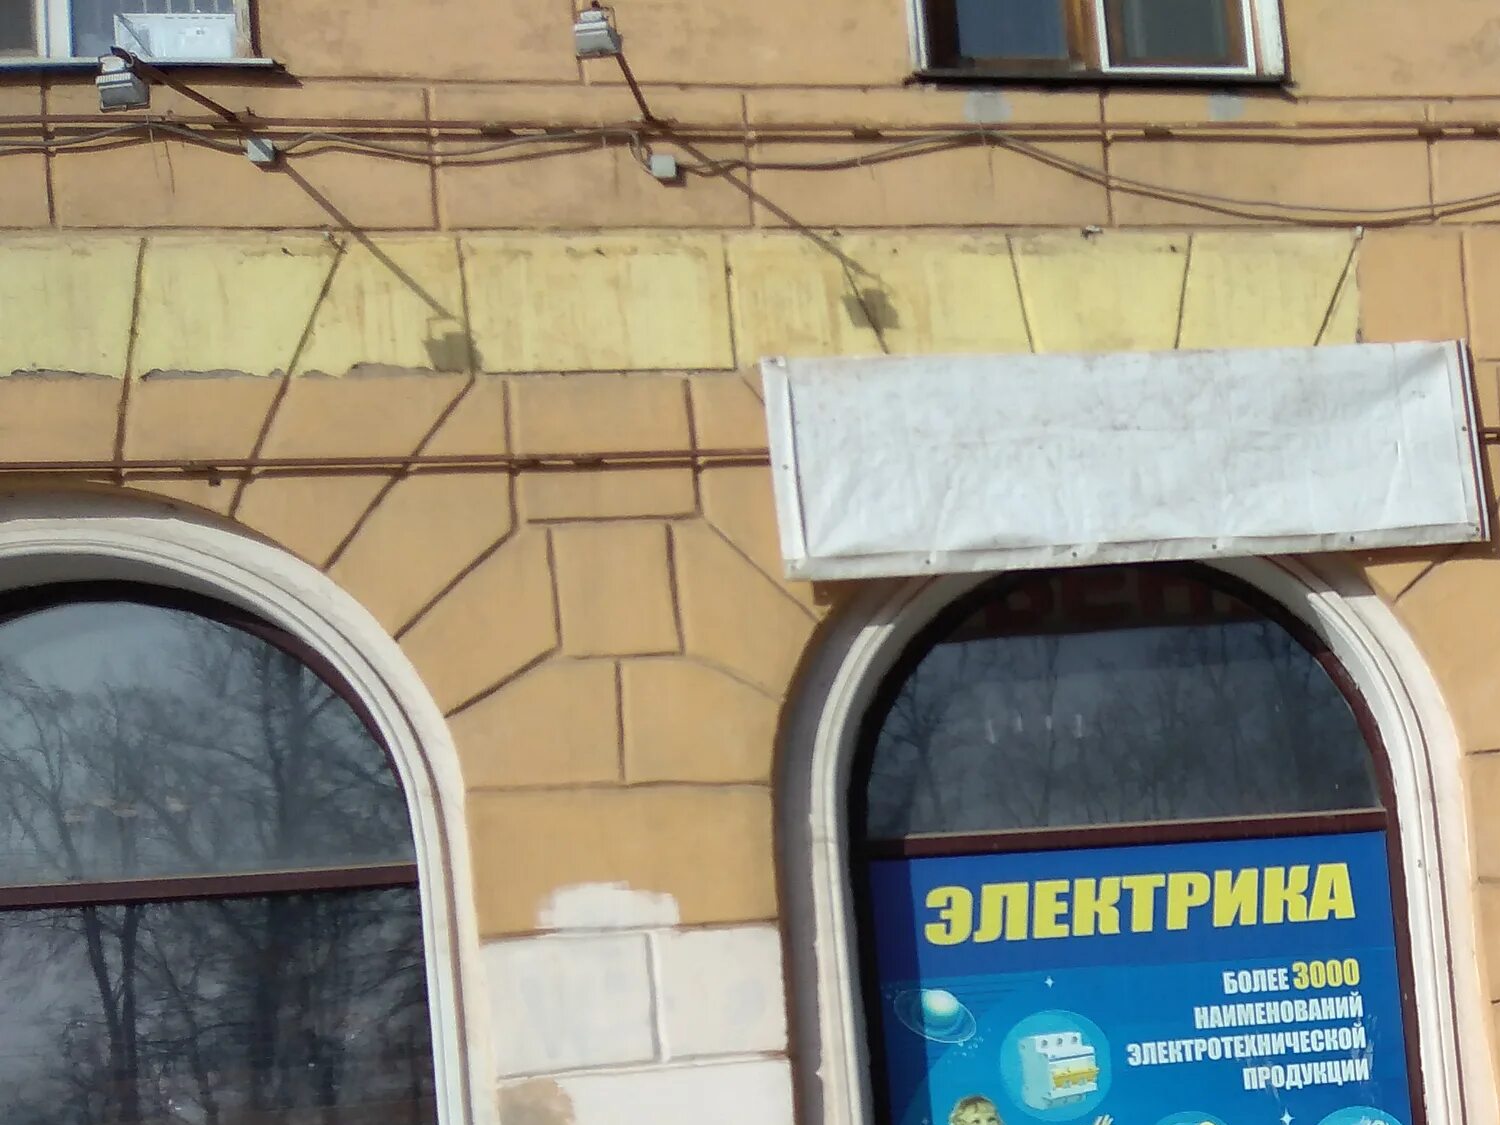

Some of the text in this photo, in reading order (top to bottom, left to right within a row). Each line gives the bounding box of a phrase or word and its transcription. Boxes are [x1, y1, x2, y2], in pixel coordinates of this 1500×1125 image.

[924, 862, 1356, 946] ЭЛЕКТРИКА
[1222, 957, 1360, 995] БОЛЕЕ 3000
[1194, 991, 1364, 1030] НАИМЕНОВАНИЙ
[1126, 1022, 1367, 1067] ЭЛЕКТРОТЕХНИЧЕСКОЙ
[1243, 1058, 1371, 1091] ПРОДУКЦИИ
